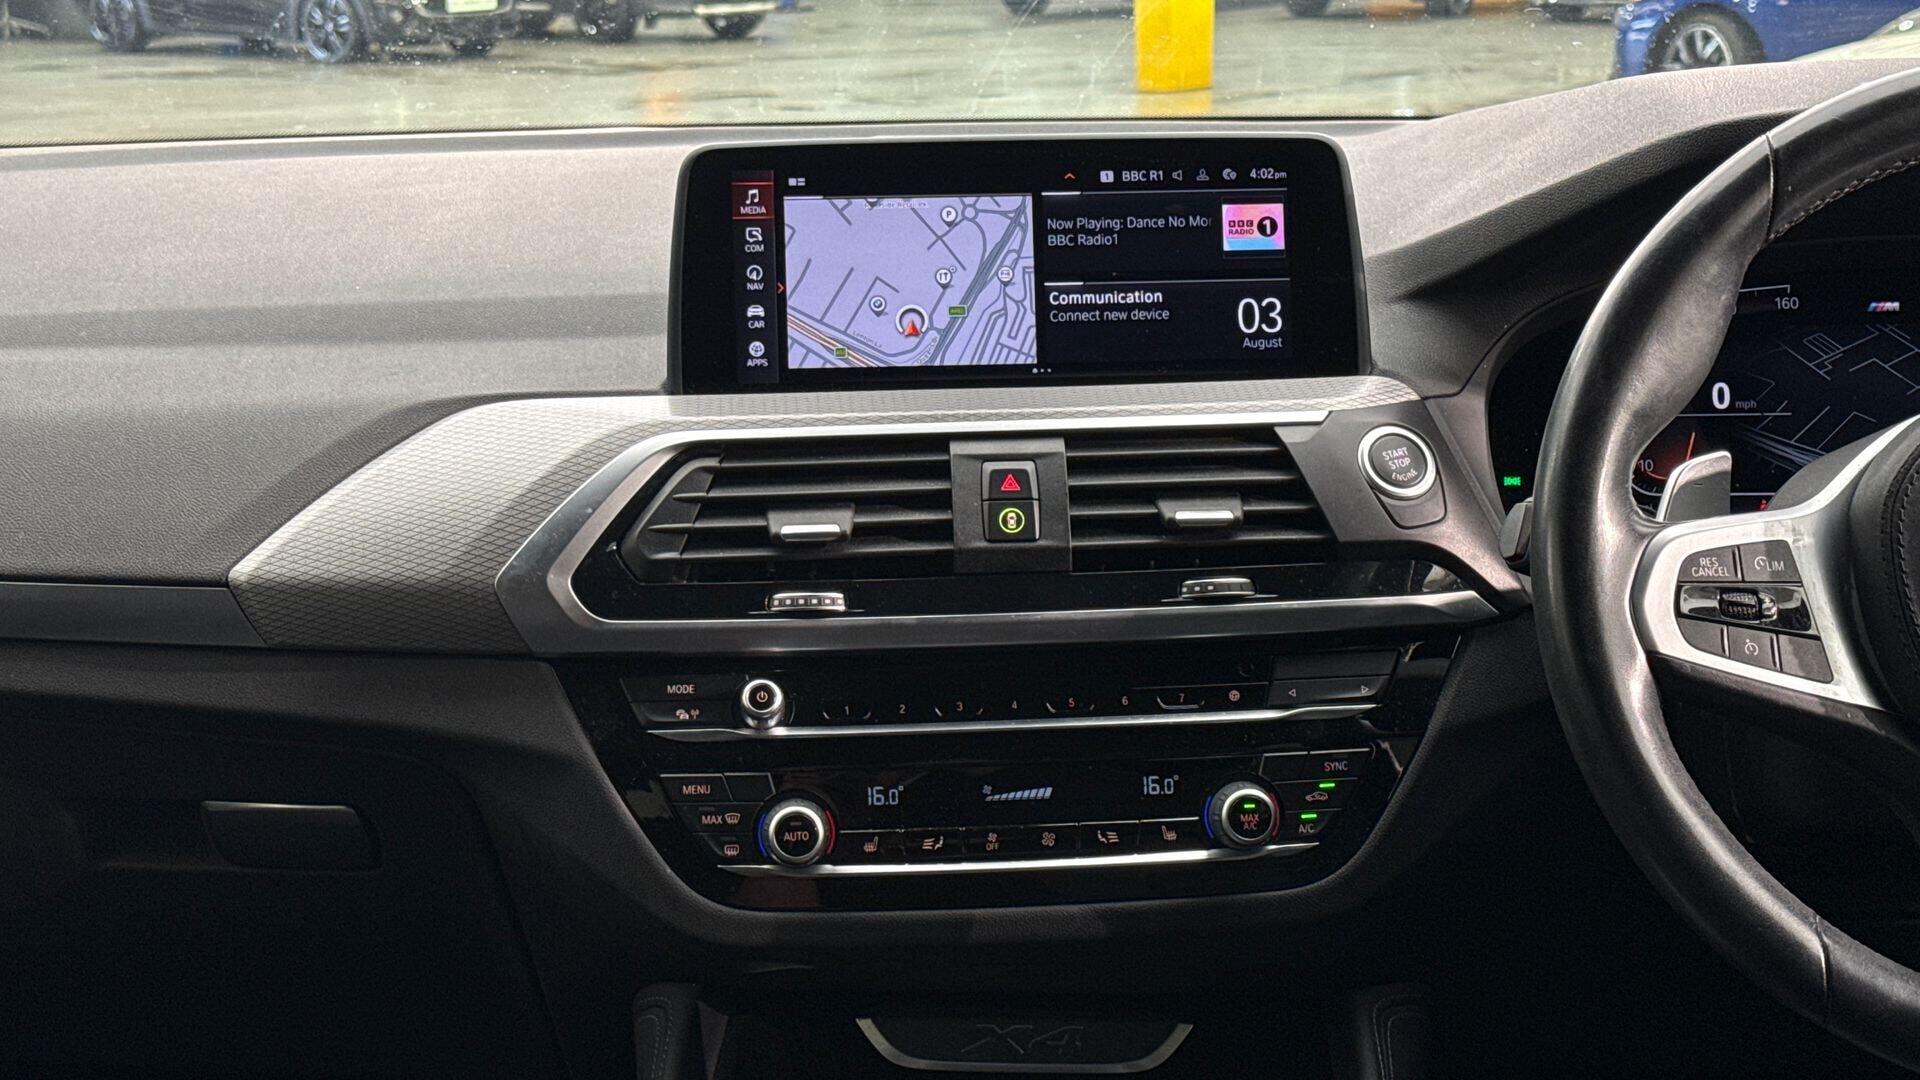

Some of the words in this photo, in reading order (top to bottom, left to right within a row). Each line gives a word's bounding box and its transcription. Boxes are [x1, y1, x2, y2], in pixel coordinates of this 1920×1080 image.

[1122, 170, 1147, 182] BBC
[1150, 170, 1164, 181] R1
[1250, 168, 1287, 180] 4:02pm
[740, 206, 766, 215] MEDIA
[1047, 218, 1074, 230] Now
[1077, 217, 1124, 232] Playing:
[1127, 216, 1166, 229] Dance
[1169, 216, 1186, 228] No
[1262, 218, 1272, 236] 1
[1228, 228, 1255, 236] RADIO
[1048, 234, 1075, 246] BBC
[1077, 233, 1119, 246] Radio1
[744, 244, 765, 253] COM
[746, 282, 765, 291] NAV
[1049, 290, 1163, 305] Communication
[1774, 296, 1799, 310] 160
[1049, 309, 1101, 322] Connect
[1103, 311, 1128, 321] new
[1131, 308, 1170, 320] device
[1237, 297, 1283, 333] 03
[747, 320, 766, 329] CAR
[1242, 336, 1283, 350] August
[746, 358, 769, 367] APPS
[1711, 382, 1731, 410] 0
[1735, 400, 1757, 410] mph
[1382, 446, 1409, 461] START
[1388, 457, 1411, 470] STOP
[1391, 468, 1419, 482] ENGINE
[1699, 557, 1719, 567] RES
[1767, 560, 1785, 572] LIM
[1691, 566, 1730, 577] CANCEL
[667, 684, 696, 694] MODE
[1068, 697, 1075, 708] 5
[1122, 695, 1129, 706] 6
[1178, 693, 1185, 703] 7
[844, 705, 850, 716] 1
[899, 704, 906, 714] 2
[956, 702, 963, 711] 3
[1011, 700, 1018, 710] 4
[1323, 760, 1349, 772] SYNC
[682, 785, 711, 795] MENU
[701, 814, 723, 825] MAX
[1240, 813, 1260, 822] MAX
[1298, 823, 1316, 833] A/C
[783, 831, 810, 842] AUTO
[985, 842, 1000, 851] OFF
